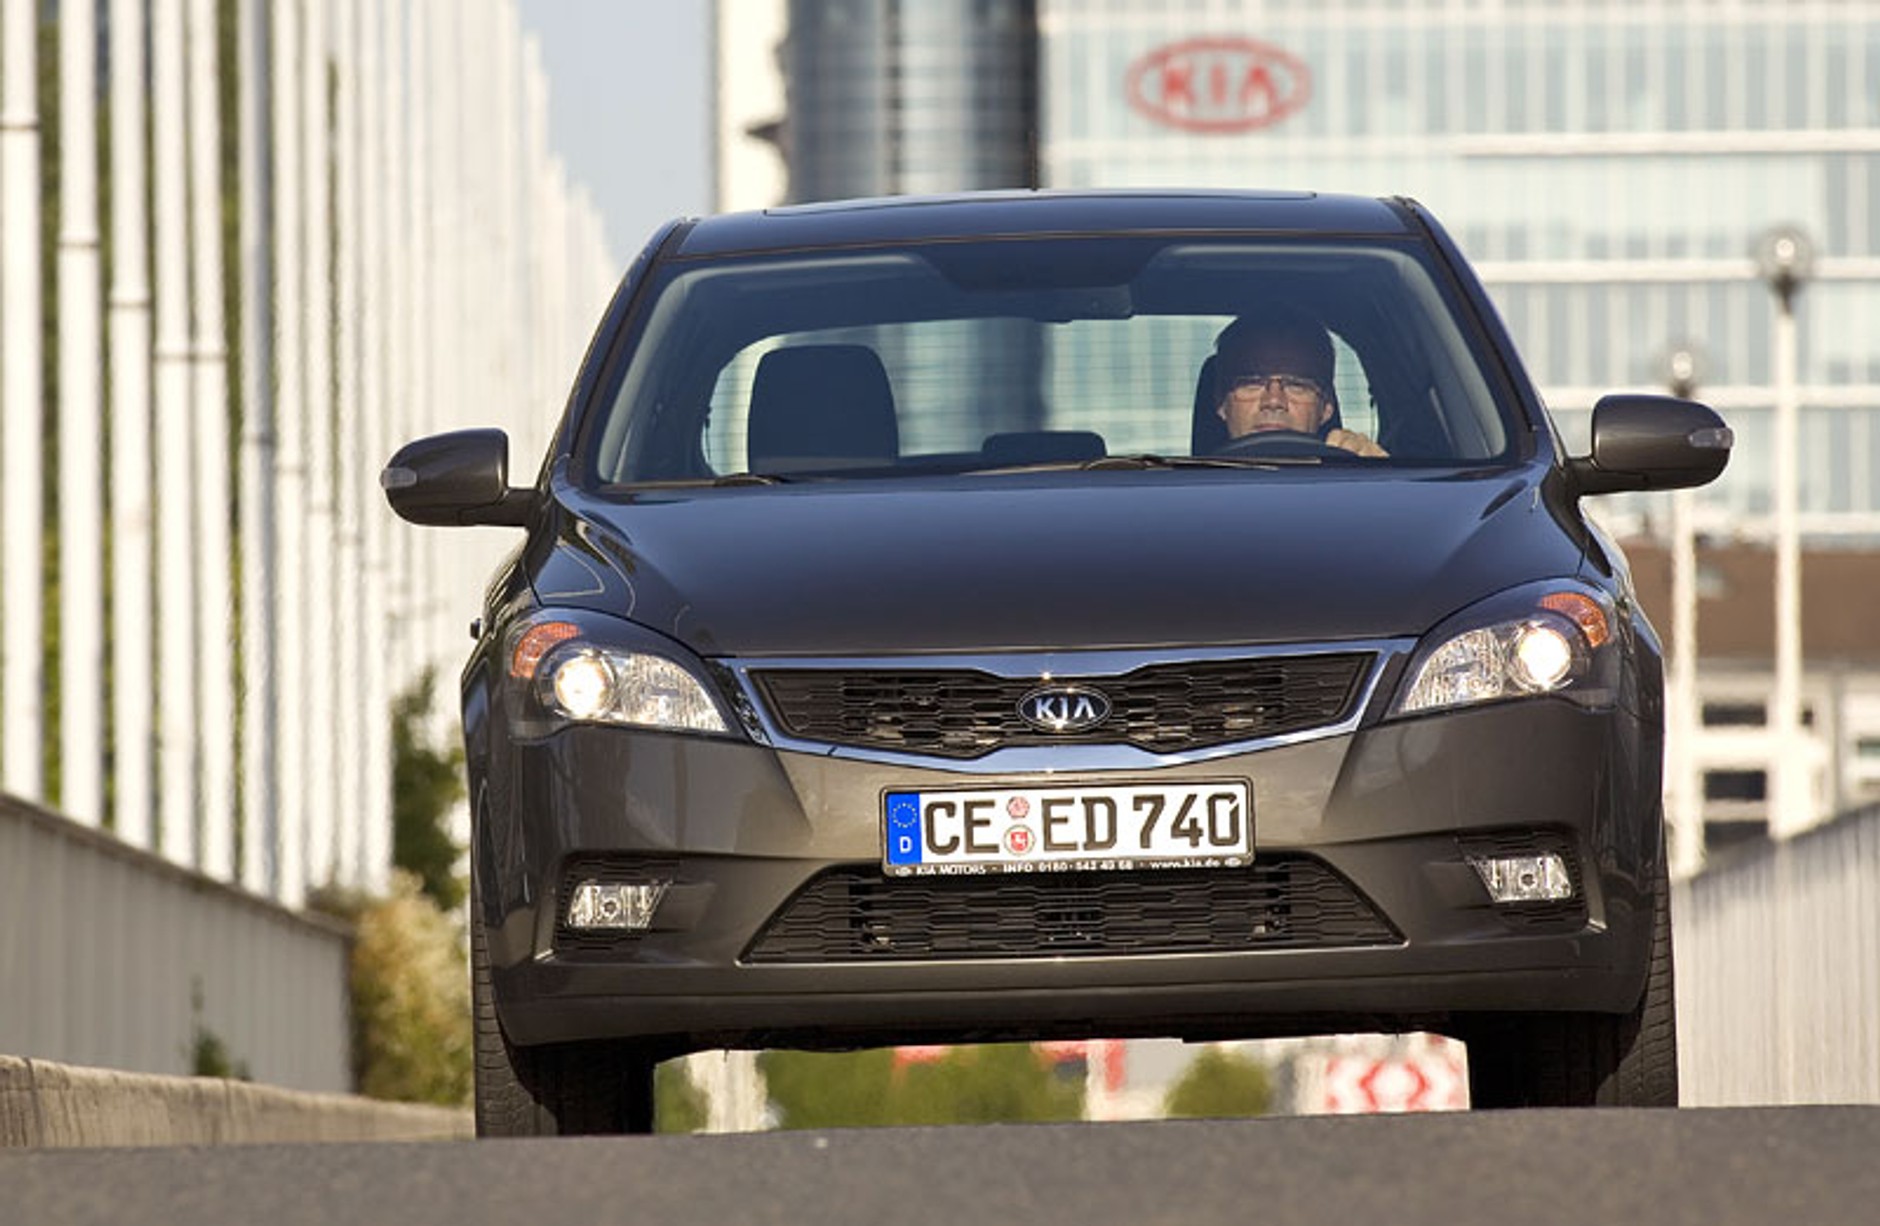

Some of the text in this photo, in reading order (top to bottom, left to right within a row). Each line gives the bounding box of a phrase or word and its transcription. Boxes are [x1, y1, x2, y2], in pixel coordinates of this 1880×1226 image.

[1161, 61, 1278, 114] KIA
[1034, 697, 1097, 720] KIA
[924, 792, 1240, 855] CE ED 740
[899, 836, 913, 854] D
[916, 864, 936, 875] KIA
[939, 863, 987, 875] MOTORS
[1003, 861, 1033, 873] INFO
[1149, 857, 1221, 869] www.kia.de
